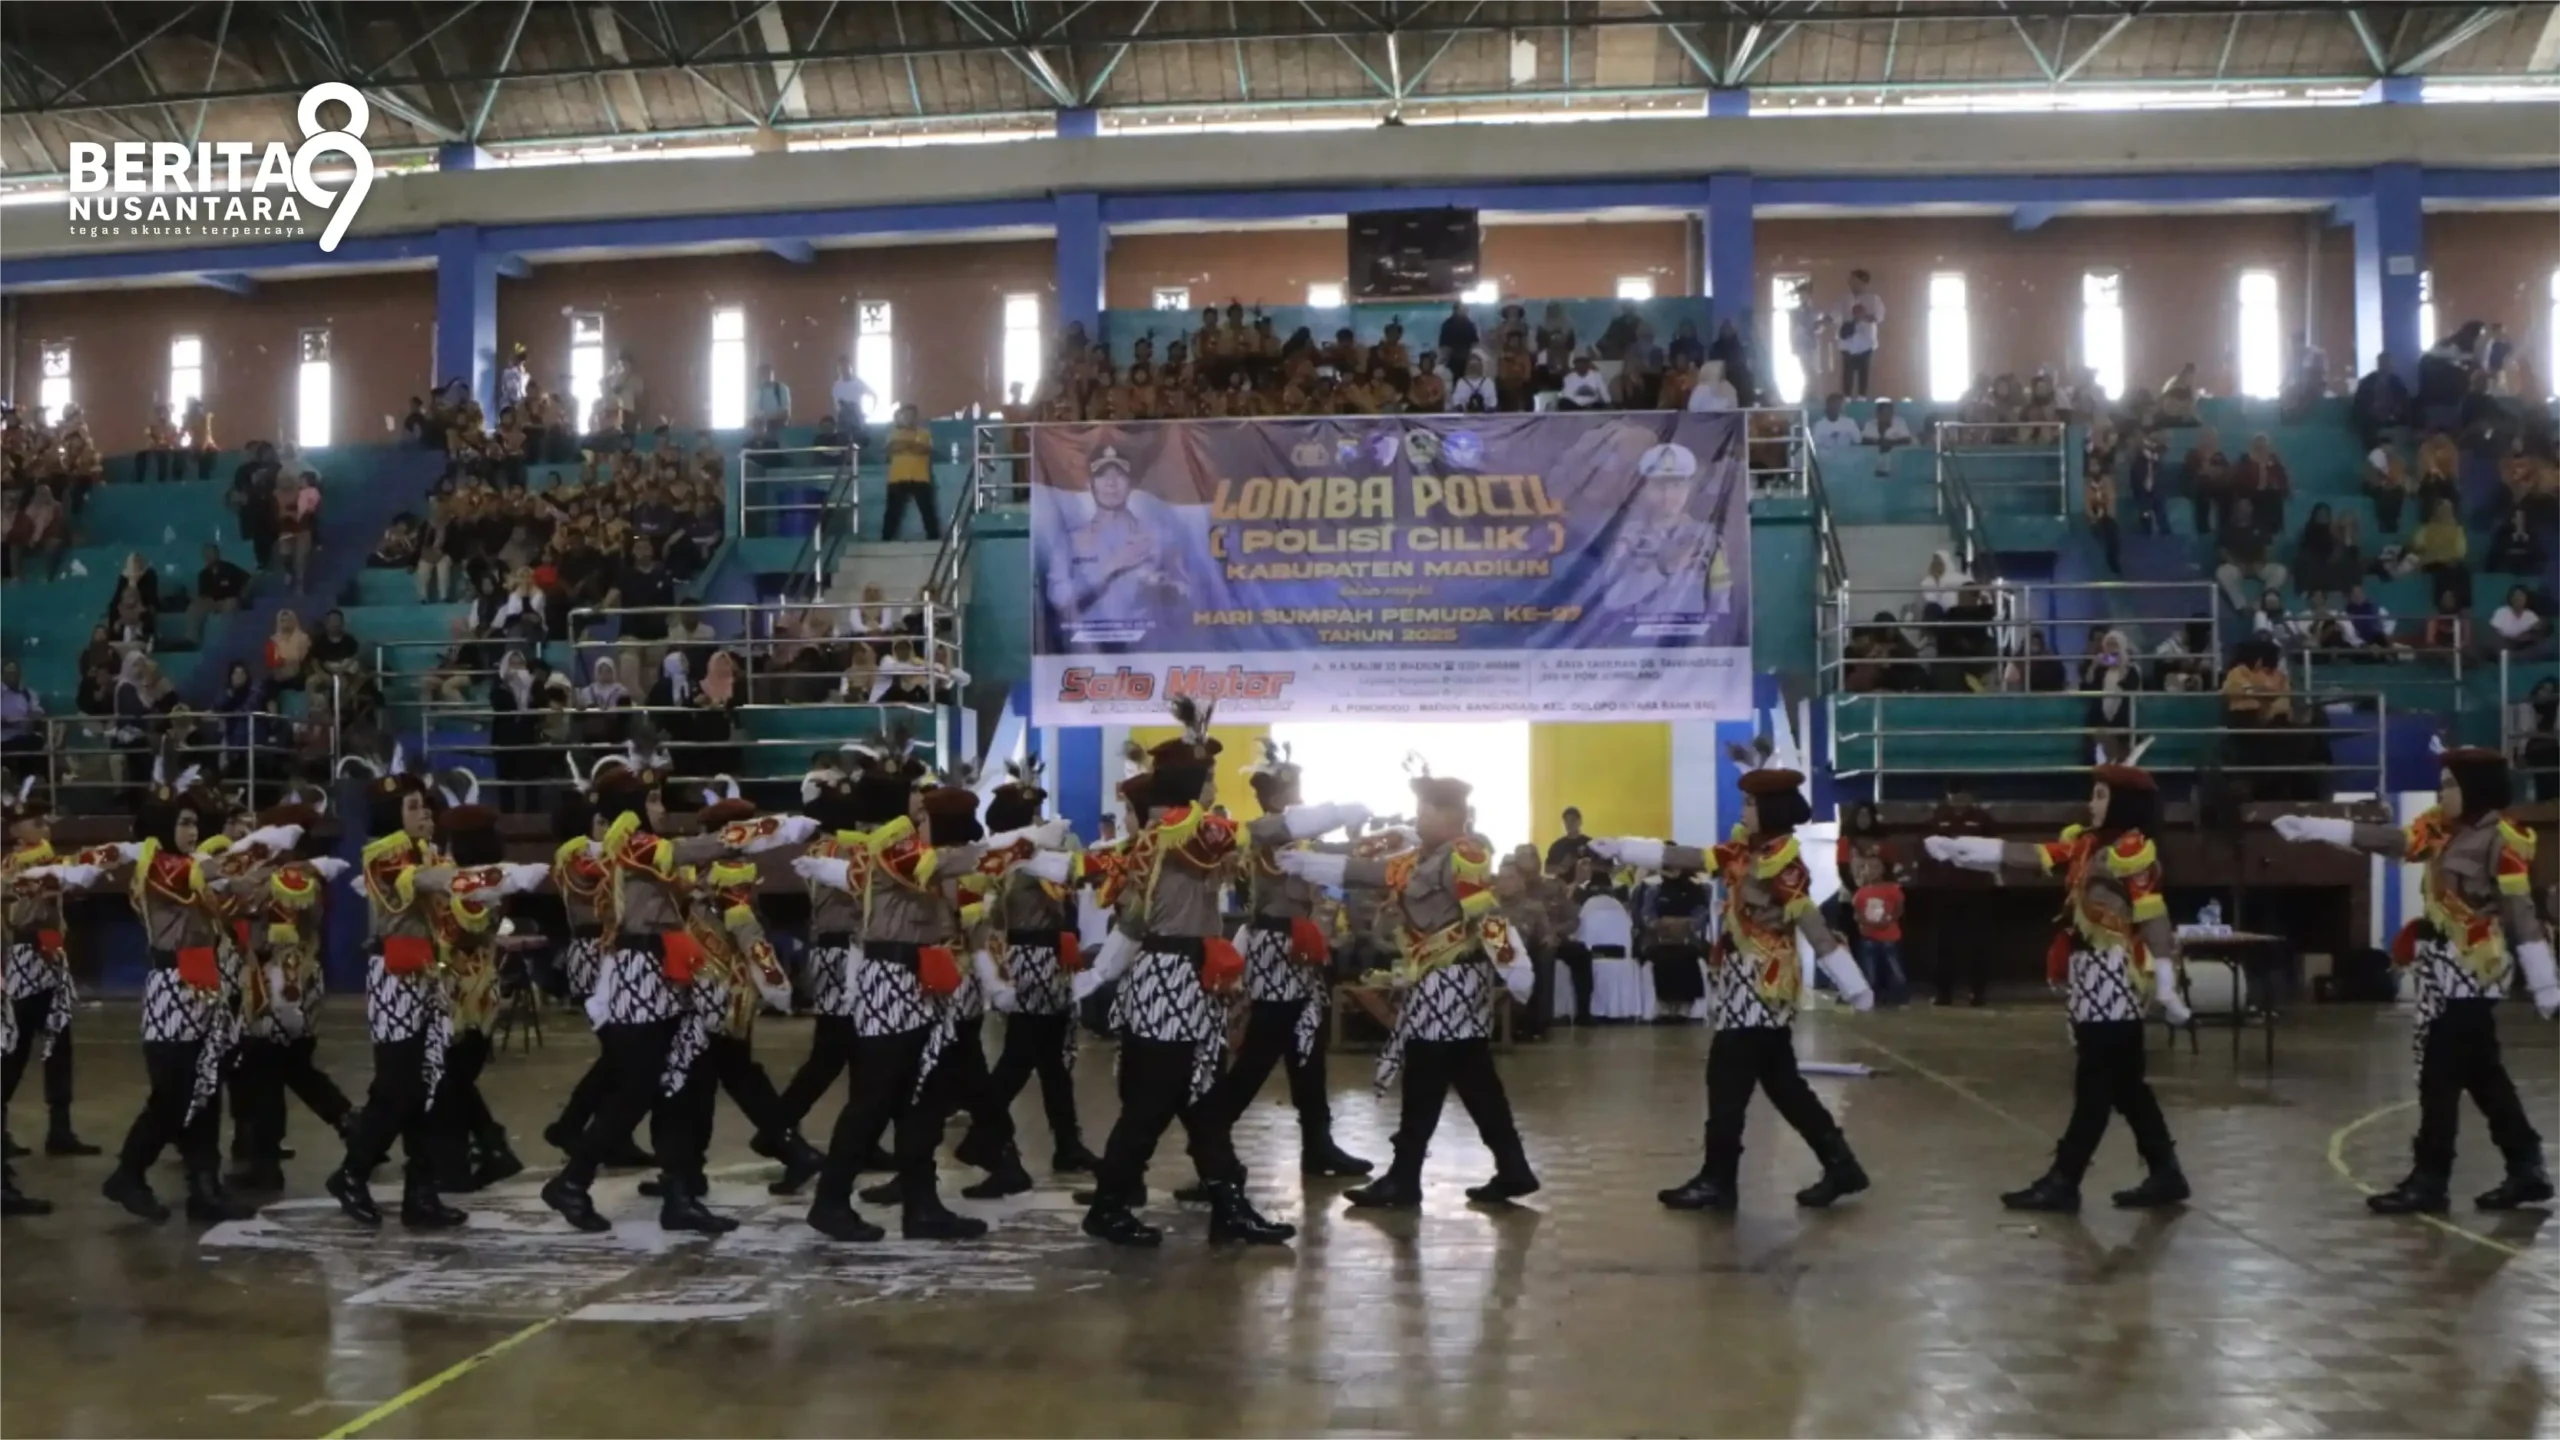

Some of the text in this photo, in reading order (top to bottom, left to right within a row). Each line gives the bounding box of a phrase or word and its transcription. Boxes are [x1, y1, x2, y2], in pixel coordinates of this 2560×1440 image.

[1212, 474, 1565, 520] LOMBA POCIL
[1241, 525, 1397, 554] POLISI
[1406, 525, 1531, 552] CILIK
[1226, 558, 1550, 580] KABUPATEN MADIUN
[1192, 608, 1253, 625] HARI
[1261, 608, 1374, 624] SUMPAH
[1380, 607, 1494, 623] PEMUDA
[1318, 629, 1459, 643] TAHUN 2025
[1058, 664, 1296, 703] Solo Motor
